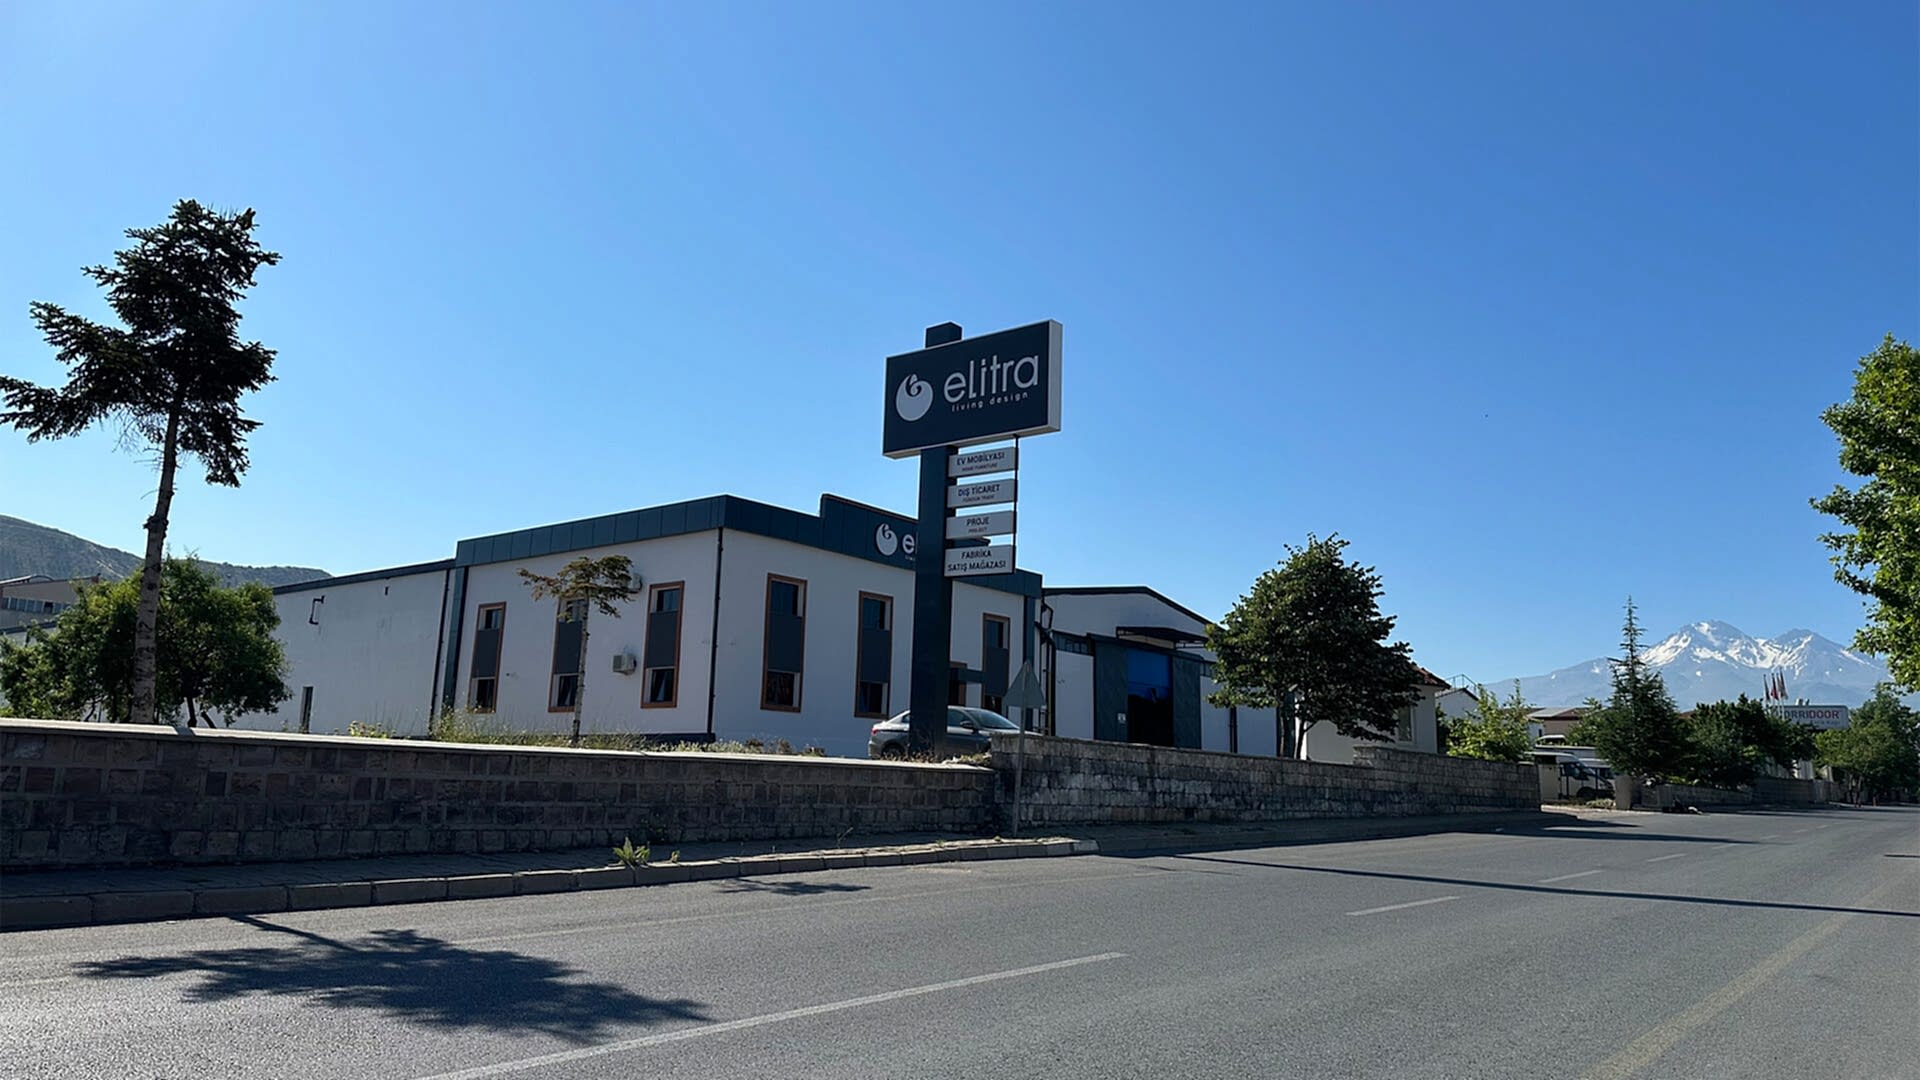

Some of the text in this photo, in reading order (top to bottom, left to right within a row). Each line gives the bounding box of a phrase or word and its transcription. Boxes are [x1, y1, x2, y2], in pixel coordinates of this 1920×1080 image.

[944, 355, 1039, 403] elitra
[952, 392, 1028, 412] living design
[956, 457, 967, 466] EV
[971, 484, 1000, 495] TİCARET
[966, 517, 990, 526] PROJE
[961, 548, 992, 560] FABRİKA
[947, 562, 968, 572] SATIŞ
